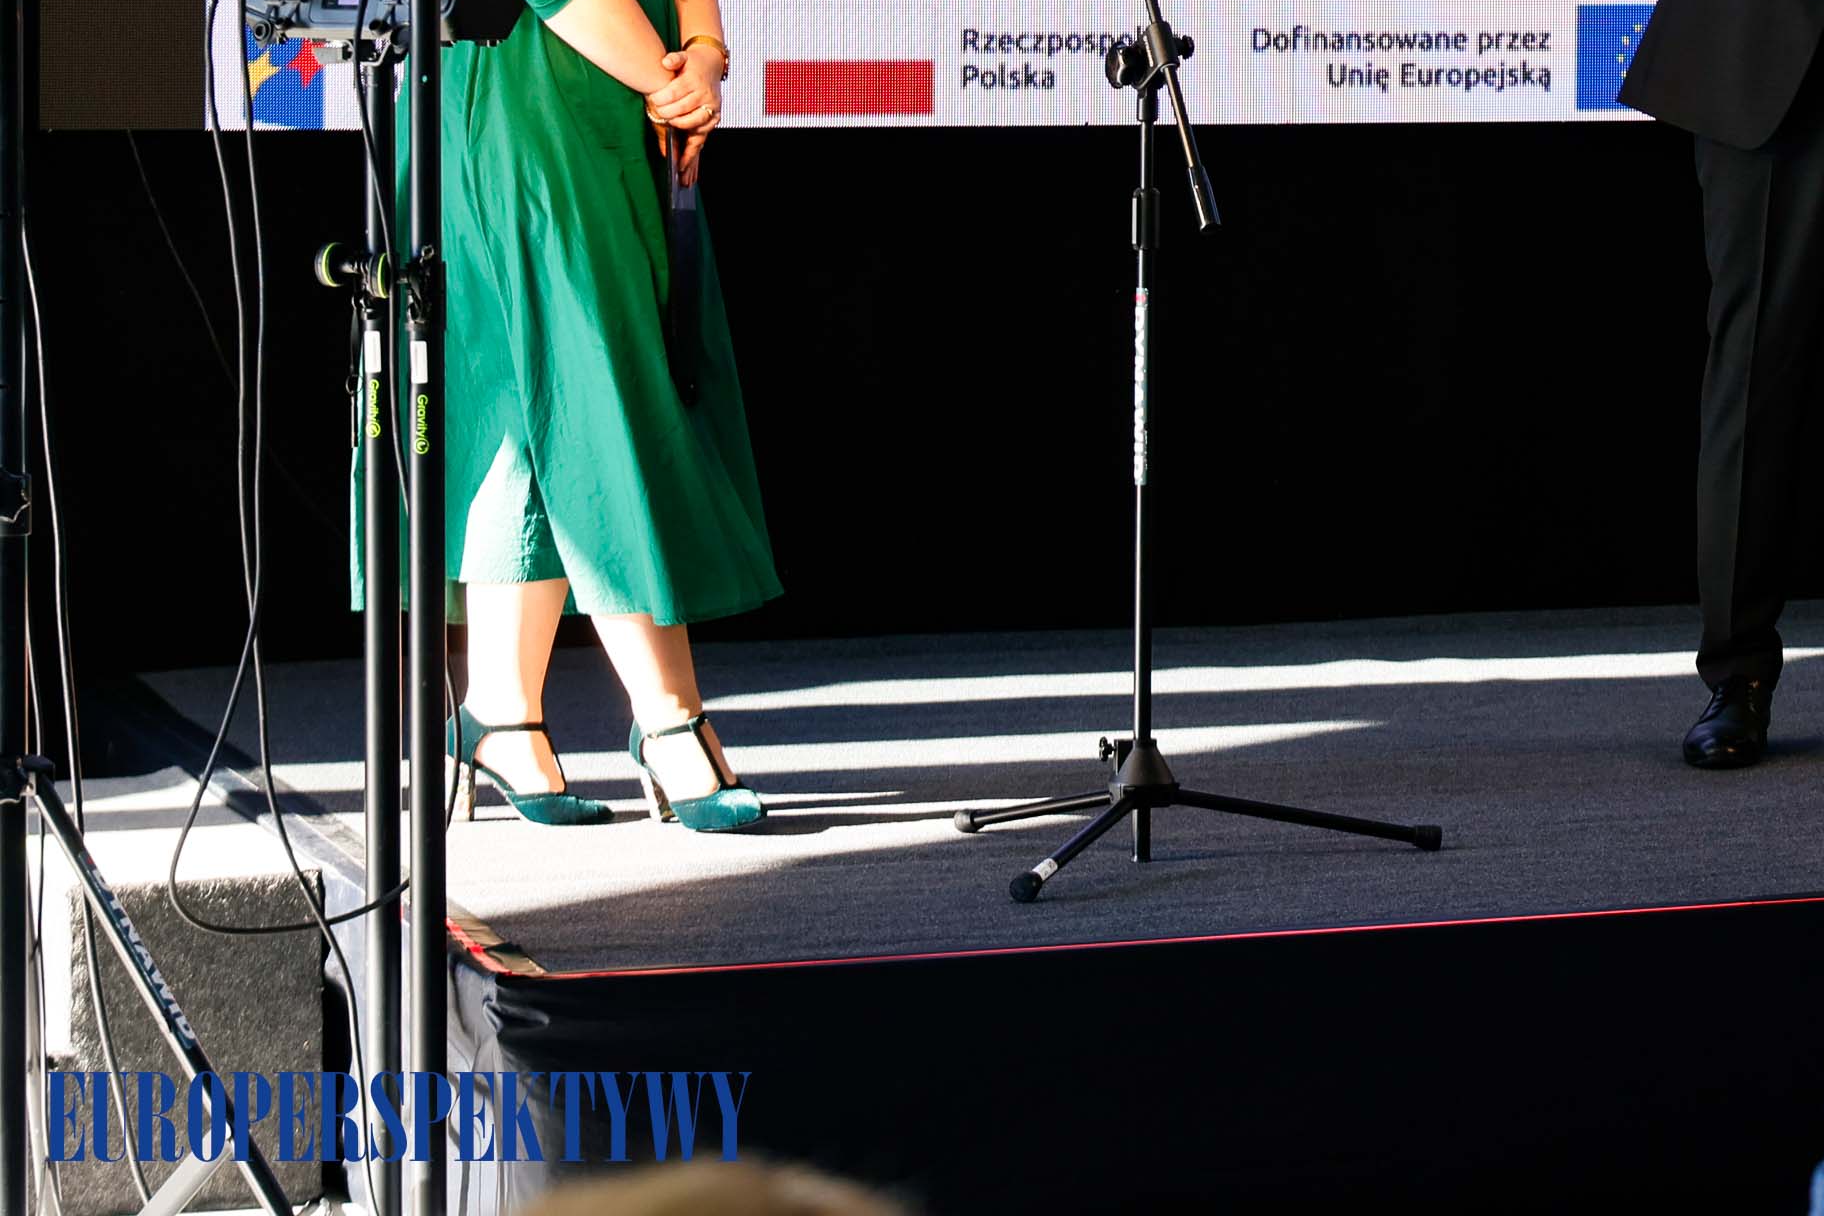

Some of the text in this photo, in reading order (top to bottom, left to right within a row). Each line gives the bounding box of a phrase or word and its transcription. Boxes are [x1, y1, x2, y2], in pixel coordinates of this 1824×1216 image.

[1252, 25, 1551, 55] Dofinansowane przez
[962, 62, 1055, 89] Polska
[1328, 61, 1551, 93] Unię Europejską
[416, 394, 429, 438] Gravity
